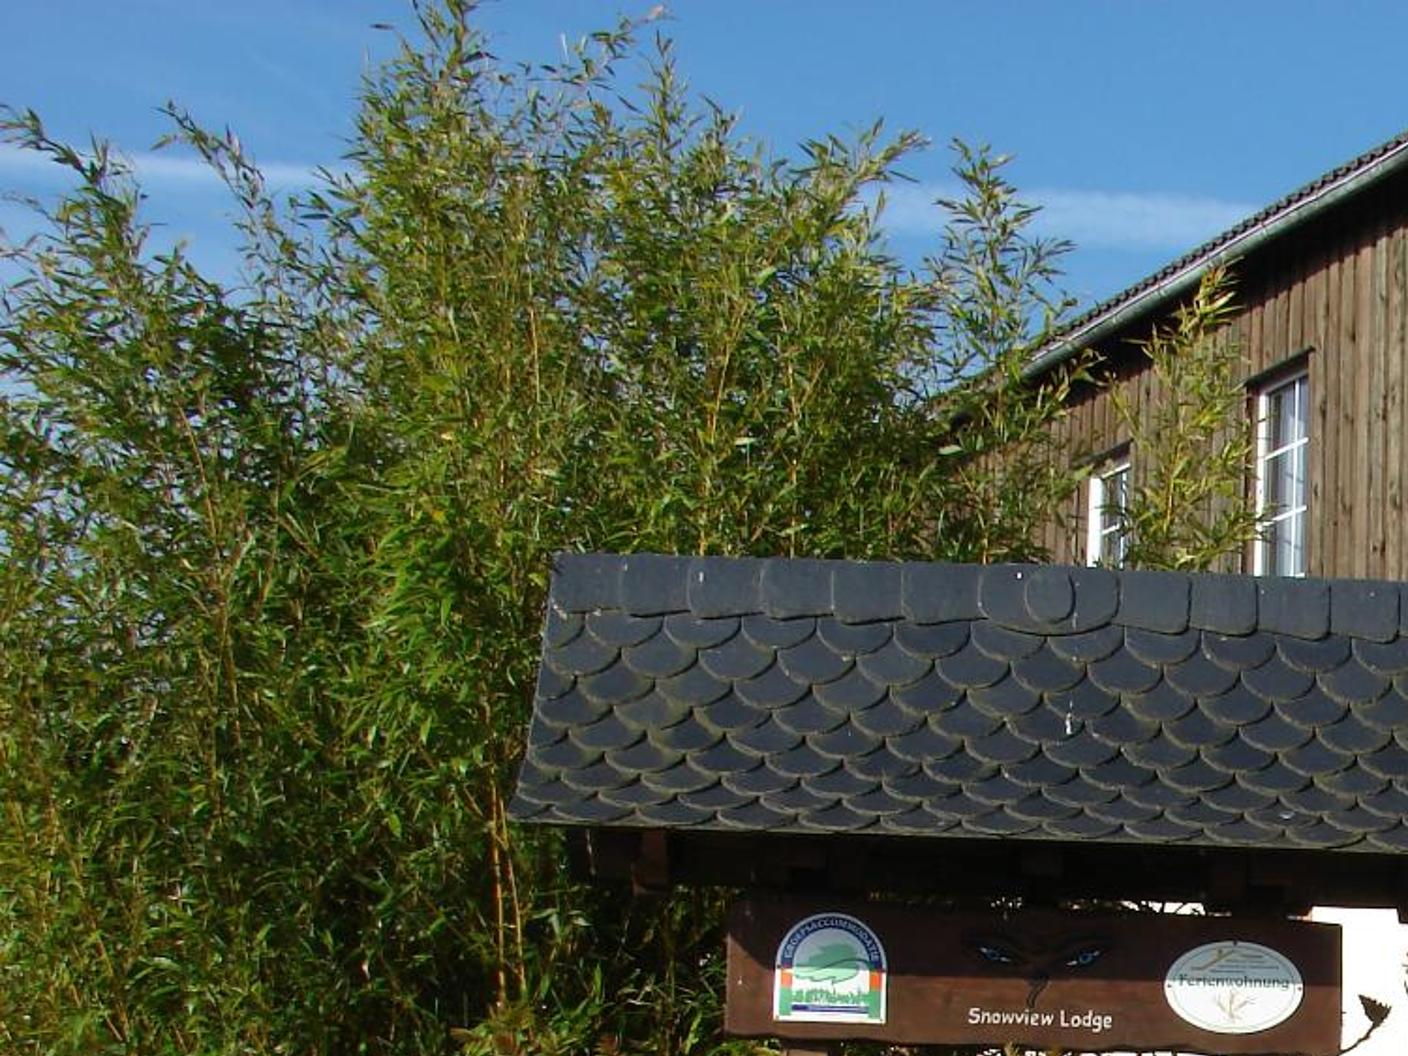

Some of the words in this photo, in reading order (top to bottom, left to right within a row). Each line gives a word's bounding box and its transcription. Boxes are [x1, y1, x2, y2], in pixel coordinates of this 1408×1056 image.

[1178, 972, 1290, 992] Ferienwohnung
[967, 1007, 1055, 1027] Snowview
[1059, 1010, 1113, 1033] Lodge
